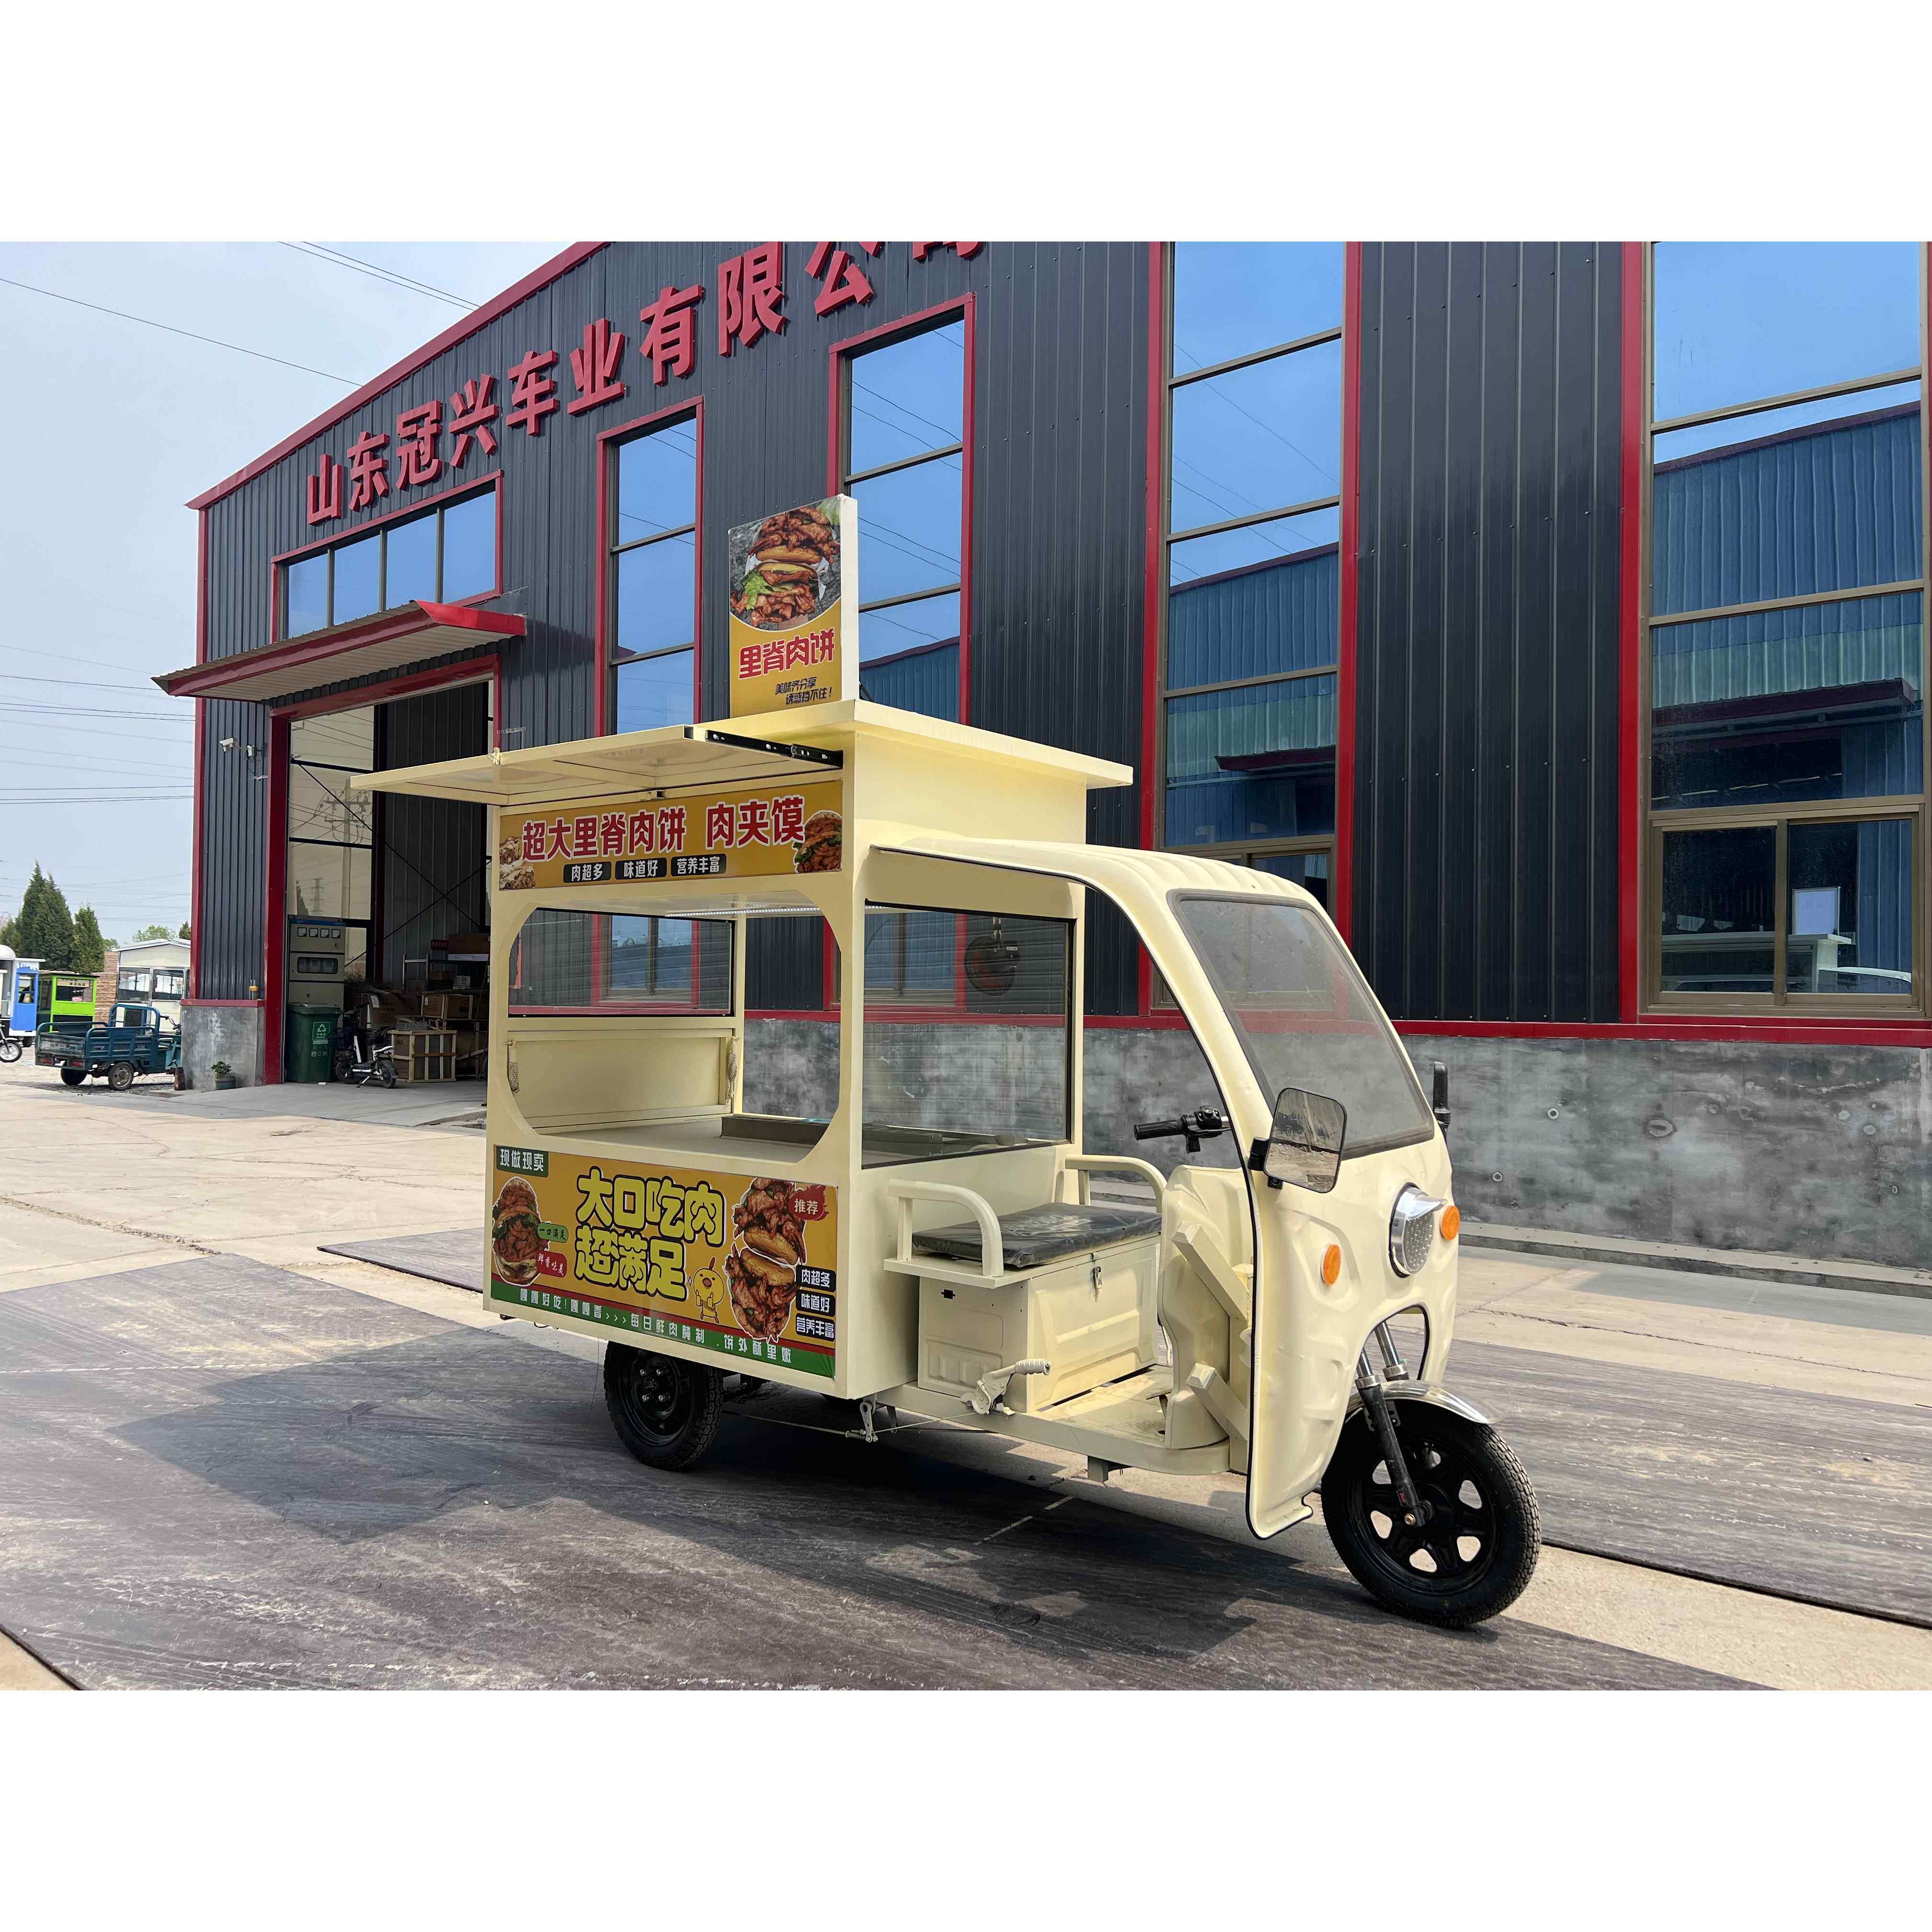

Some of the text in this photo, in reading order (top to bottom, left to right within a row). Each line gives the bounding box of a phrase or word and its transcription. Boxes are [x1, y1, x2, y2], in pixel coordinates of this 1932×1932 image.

[307, 242, 981, 525] 山东冠兴车业有限公
[739, 627, 835, 678] 里脊肉饼
[775, 677, 817, 695] 美味齐分享
[522, 795, 806, 863] 超大里脊肉饼 肉夹馍
[571, 855, 720, 882] 肉超多 味道好 营养丰富
[500, 1149, 544, 1172] 现做现卖
[576, 1167, 724, 1246] 大口吃肉
[794, 1198, 818, 1215] 推荐
[539, 1227, 566, 1241] 一口满足
[537, 1253, 564, 1276] 鲜香味美
[575, 1226, 687, 1301] 超满足
[801, 1268, 830, 1288] 肉超多
[801, 1293, 830, 1313] 味道好
[796, 1316, 834, 1339] 营养丰富
